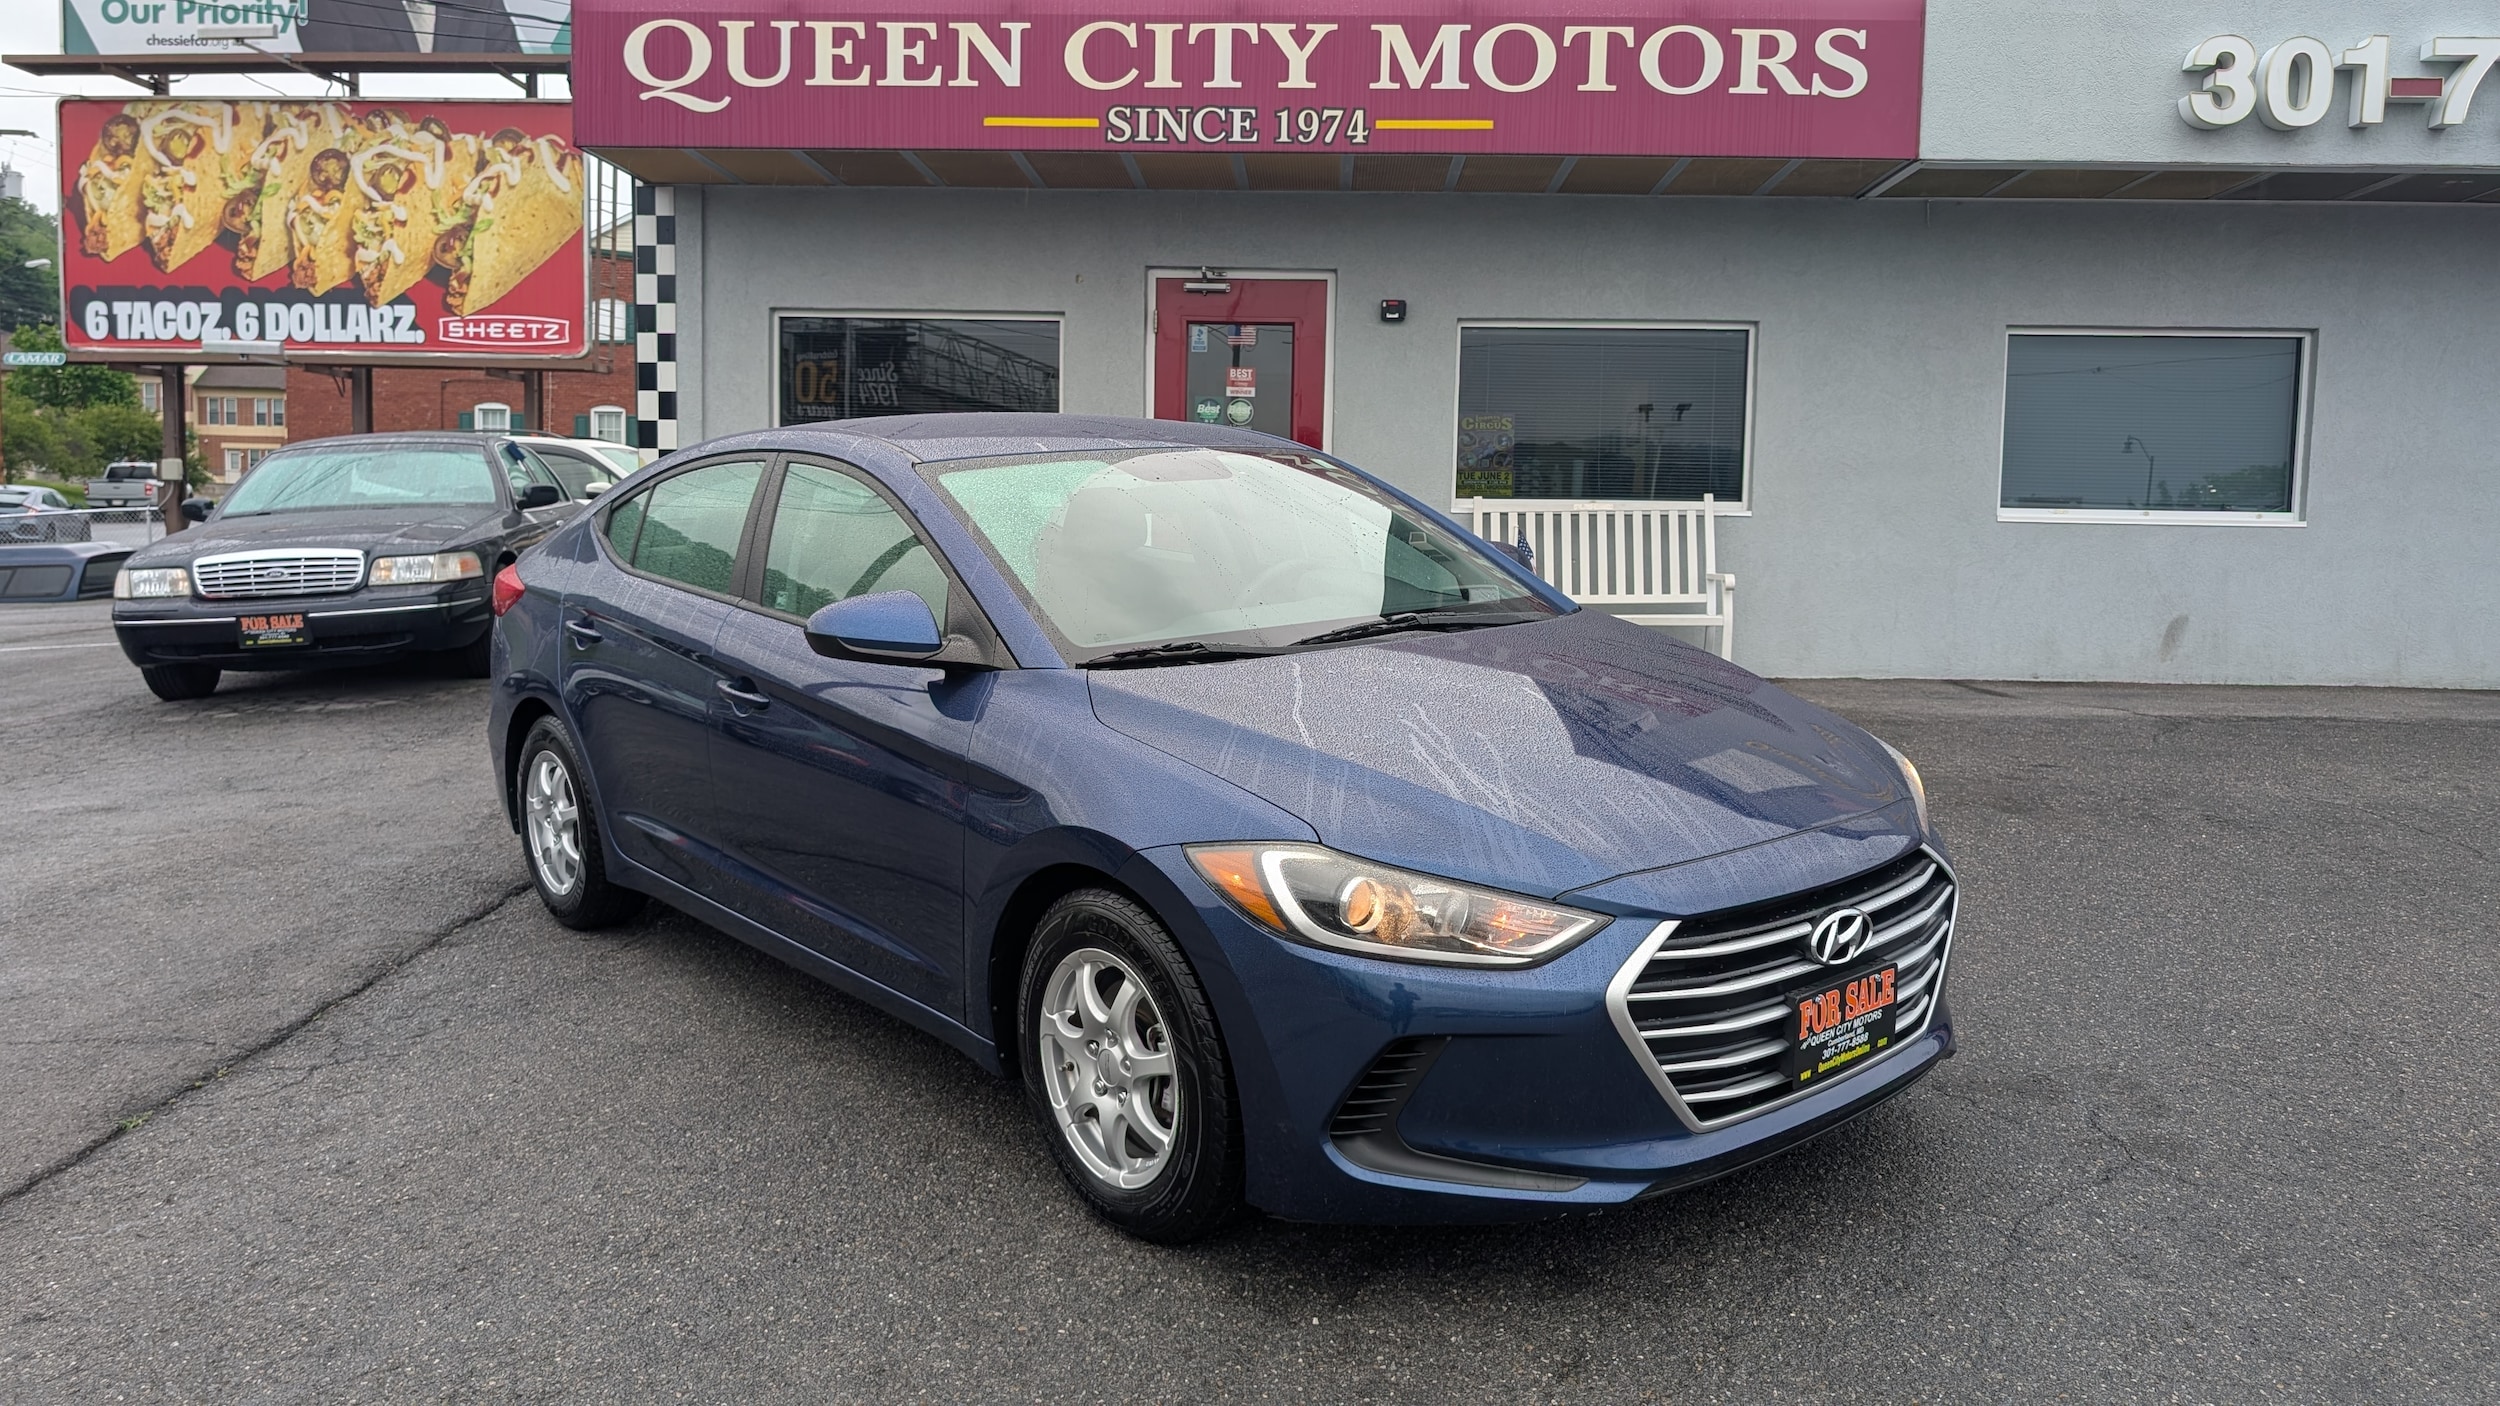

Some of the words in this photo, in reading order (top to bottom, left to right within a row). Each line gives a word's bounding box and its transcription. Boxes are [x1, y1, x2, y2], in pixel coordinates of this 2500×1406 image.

[101, 0, 166, 25] Our
[176, 0, 309, 34] Priority!
[622, 18, 1032, 113] QUEEN
[1064, 21, 1339, 90] CITY
[1368, 23, 1870, 99] MOTORS
[2177, 33, 2500, 131] 301-7
[1105, 105, 1260, 143] SINCE
[1274, 108, 1369, 145] 1974
[85, 302, 110, 341] 6
[112, 301, 232, 341] TACOZ.
[235, 303, 260, 341] 6
[264, 302, 426, 345] DOLLARZ.
[449, 321, 560, 339] SHEETZ
[8, 353, 61, 365] LAMAR
[1229, 368, 1253, 379] BEST
[1196, 404, 1221, 414] Best
[1461, 417, 1513, 430] CIRCUS
[1458, 472, 1476, 480] TUE
[1477, 472, 1503, 480] JUNE
[1503, 472, 1510, 480] 2
[240, 616, 269, 631] FOR
[269, 613, 304, 629] SALE
[1799, 988, 1842, 1040] FOR
[1845, 967, 1896, 1021] SALE
[1810, 1026, 1836, 1047] QUEEN
[1836, 1020, 1852, 1036] CITY
[1853, 1009, 1883, 1029] MOTORS
